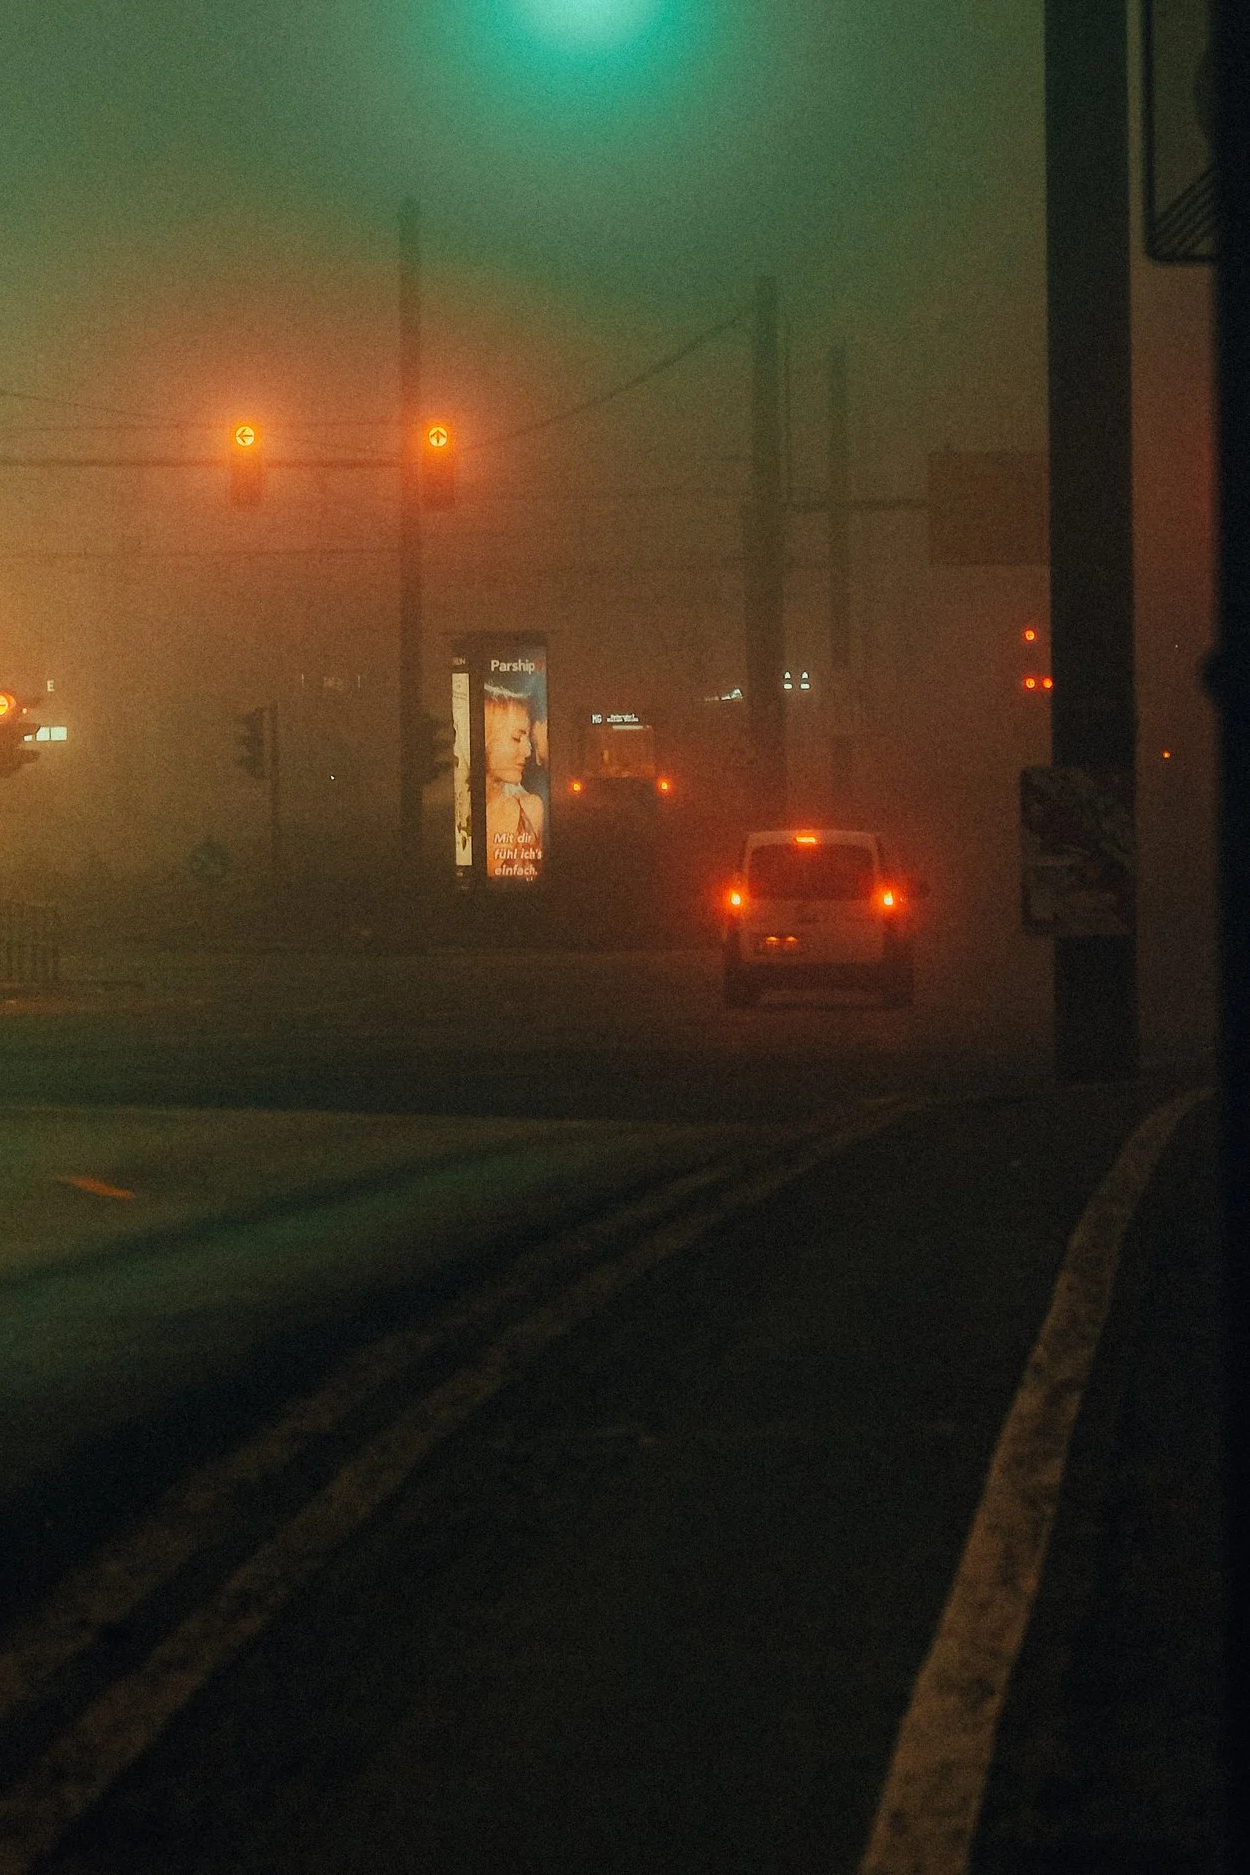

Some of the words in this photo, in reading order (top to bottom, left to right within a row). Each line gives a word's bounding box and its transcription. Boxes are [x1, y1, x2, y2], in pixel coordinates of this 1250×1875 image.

[490, 658, 535, 675] Parship
[494, 832, 514, 843] Mit
[517, 832, 532, 843] dir
[494, 848, 518, 860] fühl
[520, 847, 542, 860] ich's
[494, 864, 537, 876] einfach.
